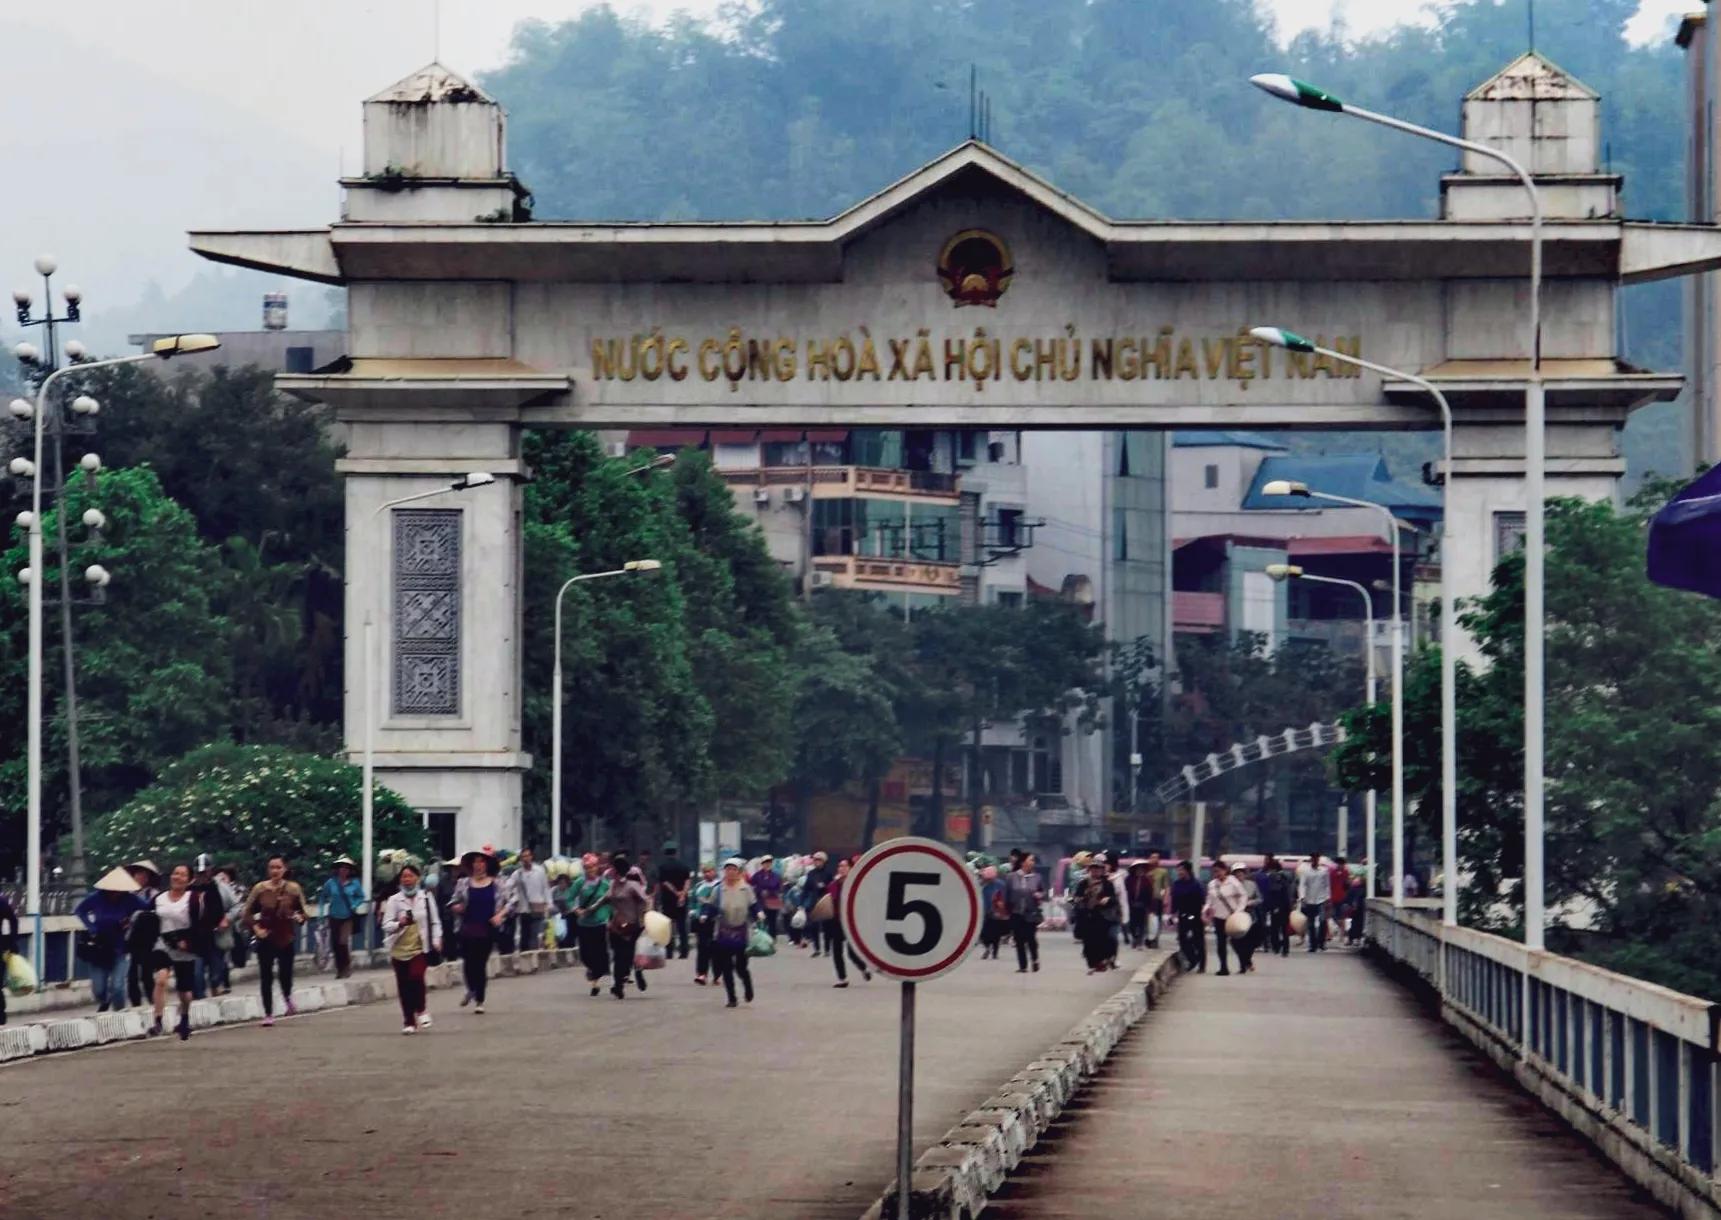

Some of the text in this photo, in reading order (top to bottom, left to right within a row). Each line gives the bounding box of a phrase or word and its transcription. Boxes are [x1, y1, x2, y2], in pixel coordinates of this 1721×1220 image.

[698, 324, 796, 392] CỘNG
[806, 325, 881, 381] HOÀ
[887, 328, 937, 381] XÃ
[944, 326, 1001, 391] HỘI
[1009, 322, 1081, 381] CHỦ
[1091, 324, 1199, 381] NGHĨA
[1201, 326, 1275, 391] VIỆT
[1286, 335, 1361, 379] NAM
[884, 870, 943, 956] 5
